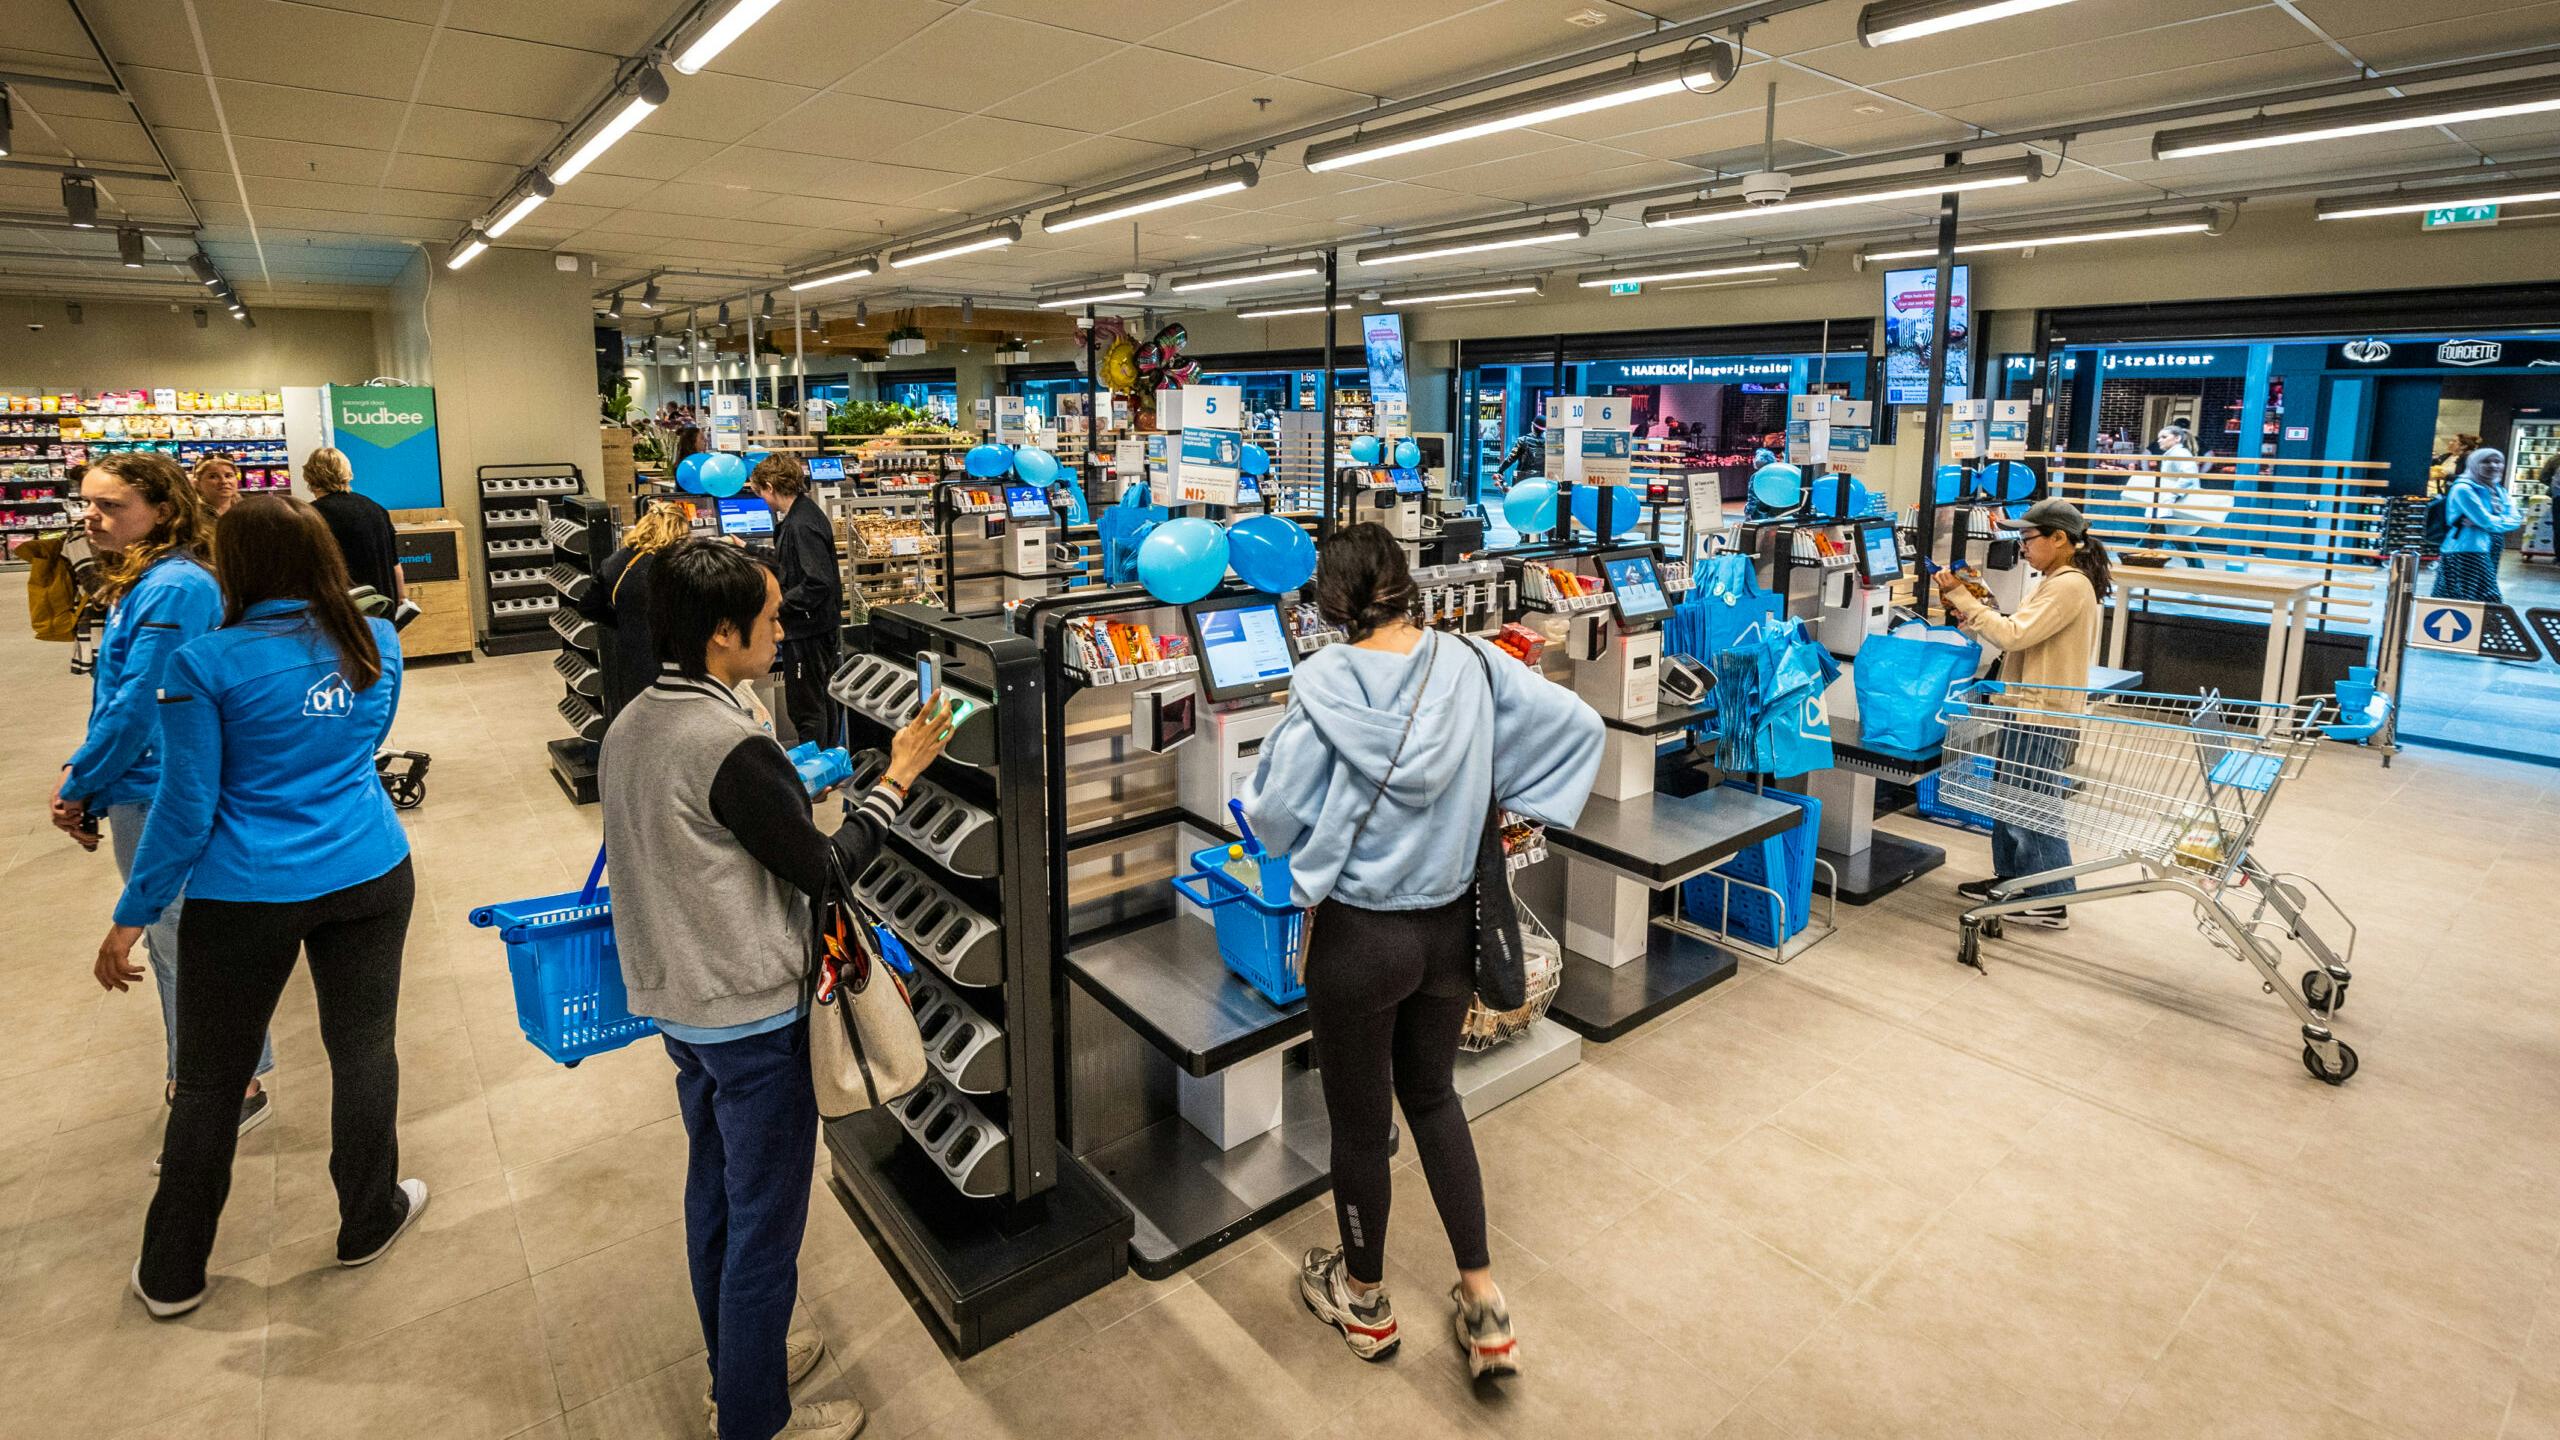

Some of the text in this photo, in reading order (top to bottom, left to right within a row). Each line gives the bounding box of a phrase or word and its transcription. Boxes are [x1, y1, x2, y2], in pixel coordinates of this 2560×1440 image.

[2441, 345, 2498, 361] FOURCHETTE
[1631, 364, 1688, 376] HAKBLOK
[1693, 363, 1792, 376] slagerij-traite
[723, 400, 732, 409] 13
[1008, 402, 1017, 410] 14
[1206, 397, 1217, 414] 5
[1959, 405, 1967, 414] 12
[2008, 405, 2016, 415] 8
[343, 407, 423, 425] budbee
[1572, 405, 1584, 417] 10
[1602, 407, 1612, 420] 6
[1847, 407, 1856, 418] 7
[399, 552, 433, 564] omerij
